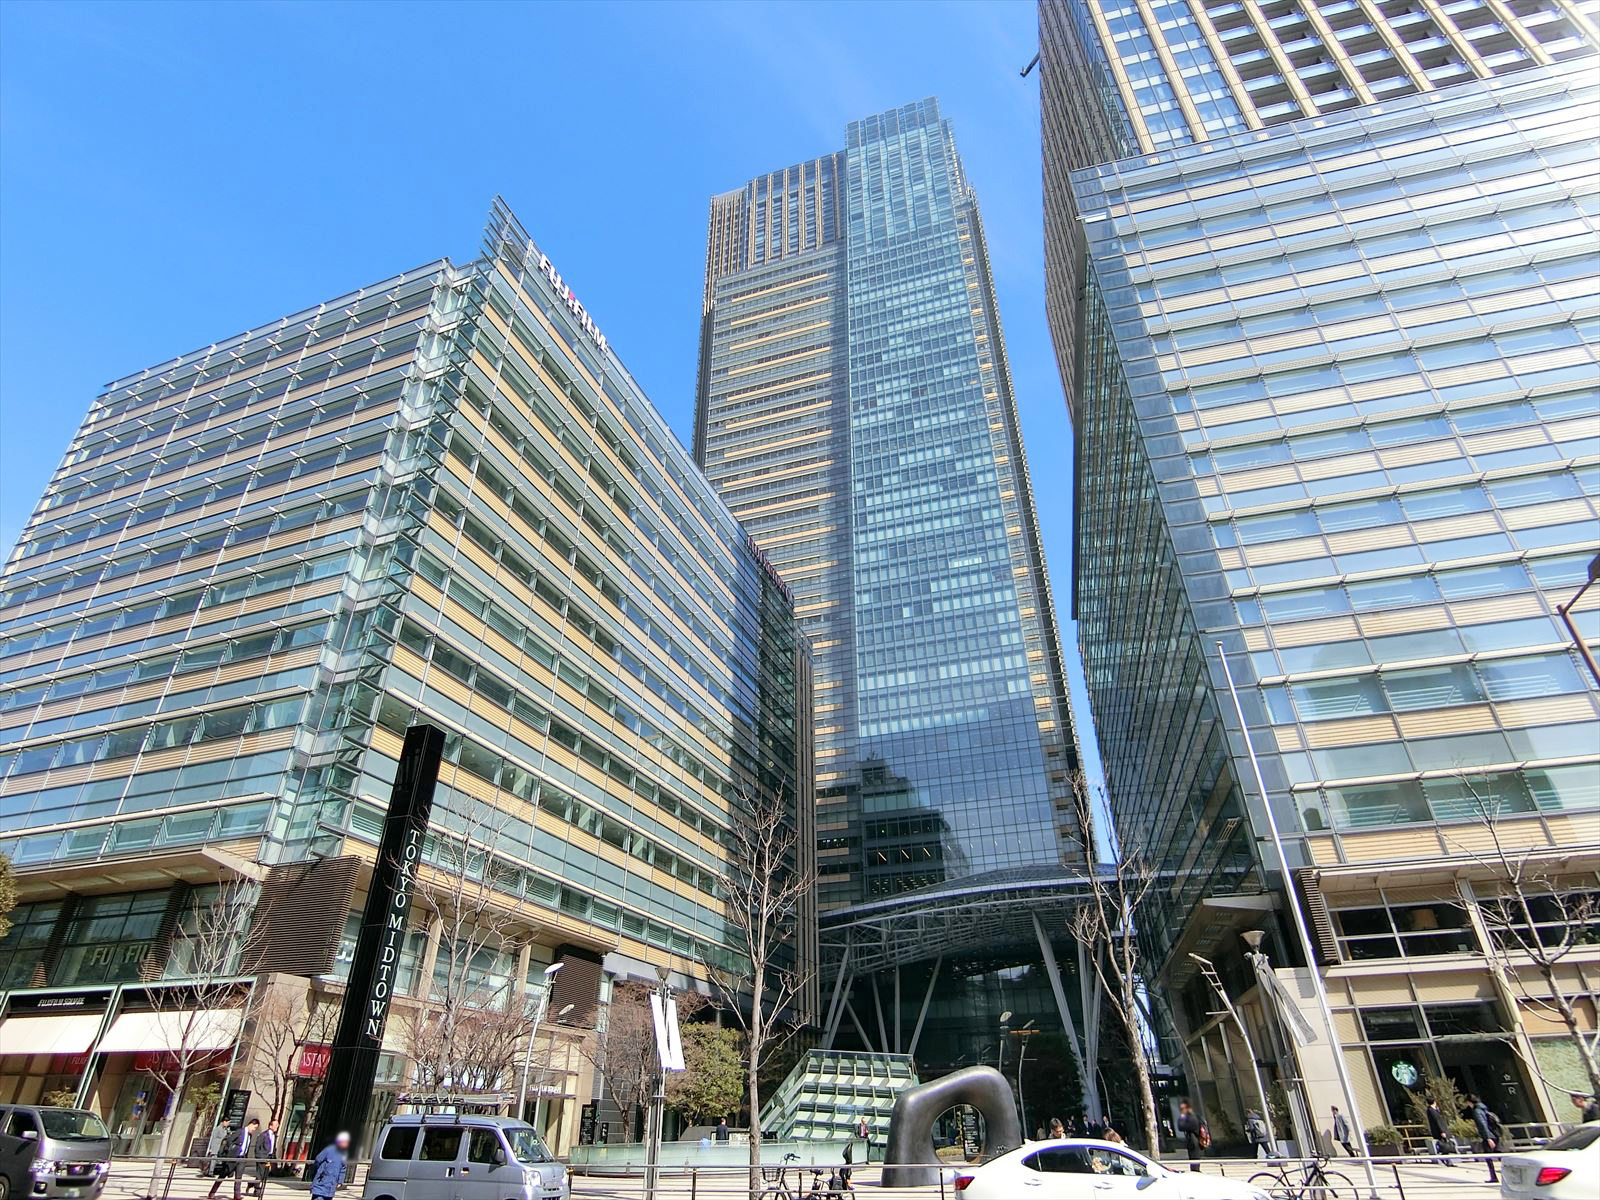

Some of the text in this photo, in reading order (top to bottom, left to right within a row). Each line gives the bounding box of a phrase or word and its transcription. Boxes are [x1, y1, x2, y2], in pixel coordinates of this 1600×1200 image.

[540, 254, 608, 352] FUJIFILM
[365, 829, 420, 1036] TOKYO MIDTOWN
